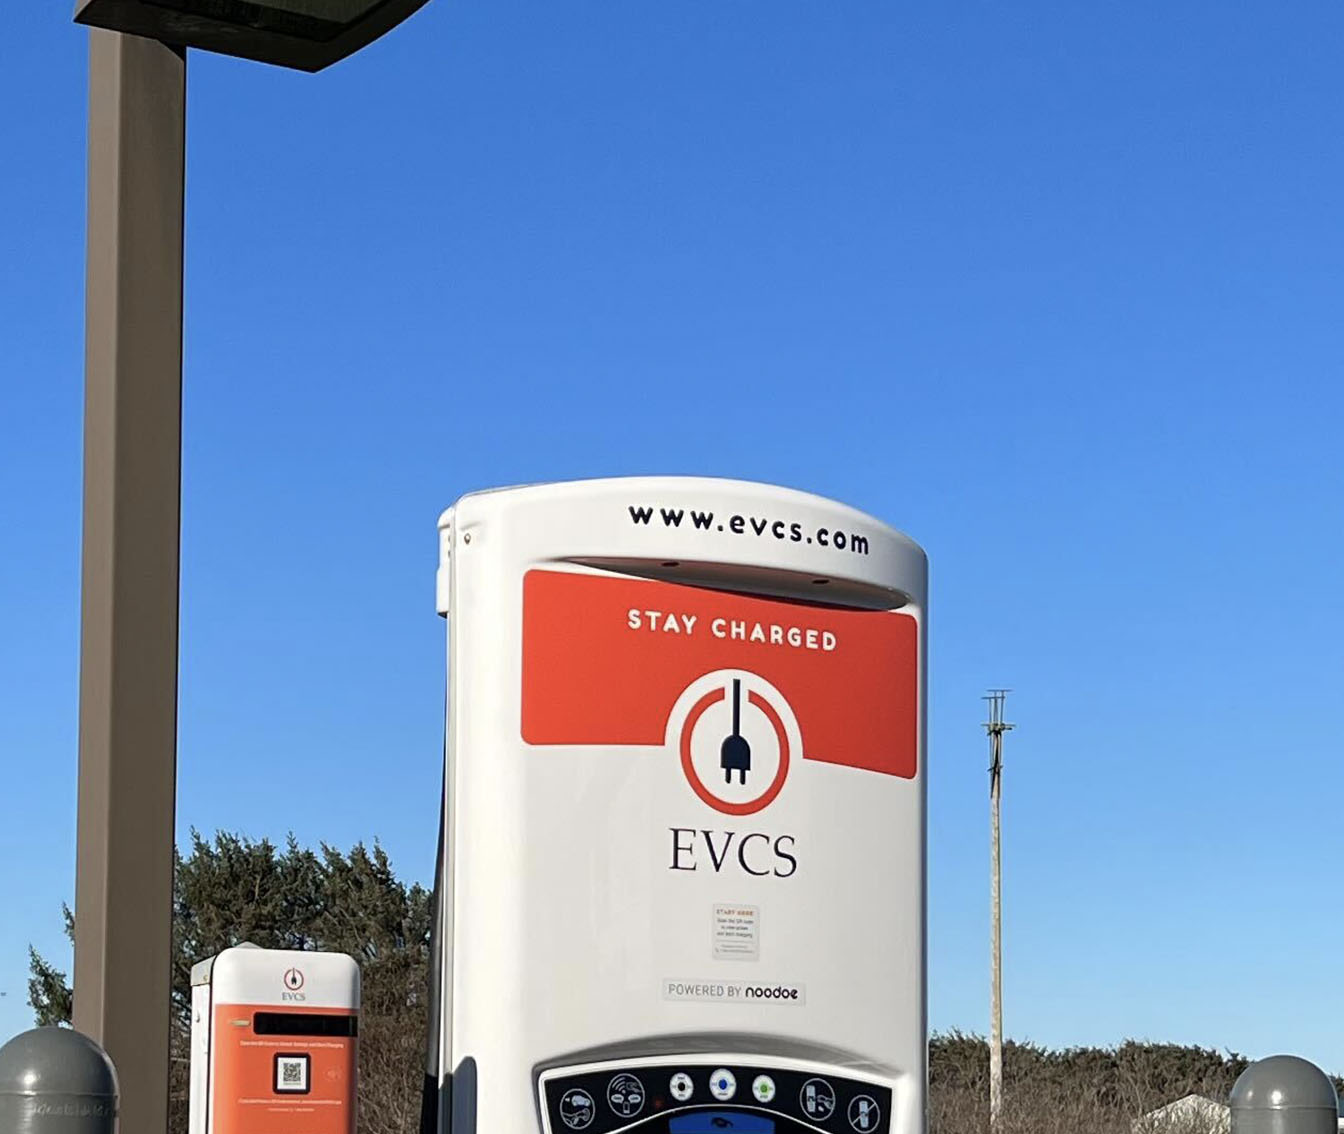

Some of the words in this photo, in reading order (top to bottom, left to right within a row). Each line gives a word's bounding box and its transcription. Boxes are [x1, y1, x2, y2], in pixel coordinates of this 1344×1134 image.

[628, 505, 870, 555] www.evcs.com
[627, 608, 697, 635] STAY
[711, 618, 837, 651] CHARGED
[668, 827, 797, 878] EVCS
[282, 992, 306, 1001] EVCS
[668, 983, 724, 997] POWERED
[727, 985, 742, 997] BY
[745, 986, 798, 1000] noodoe
